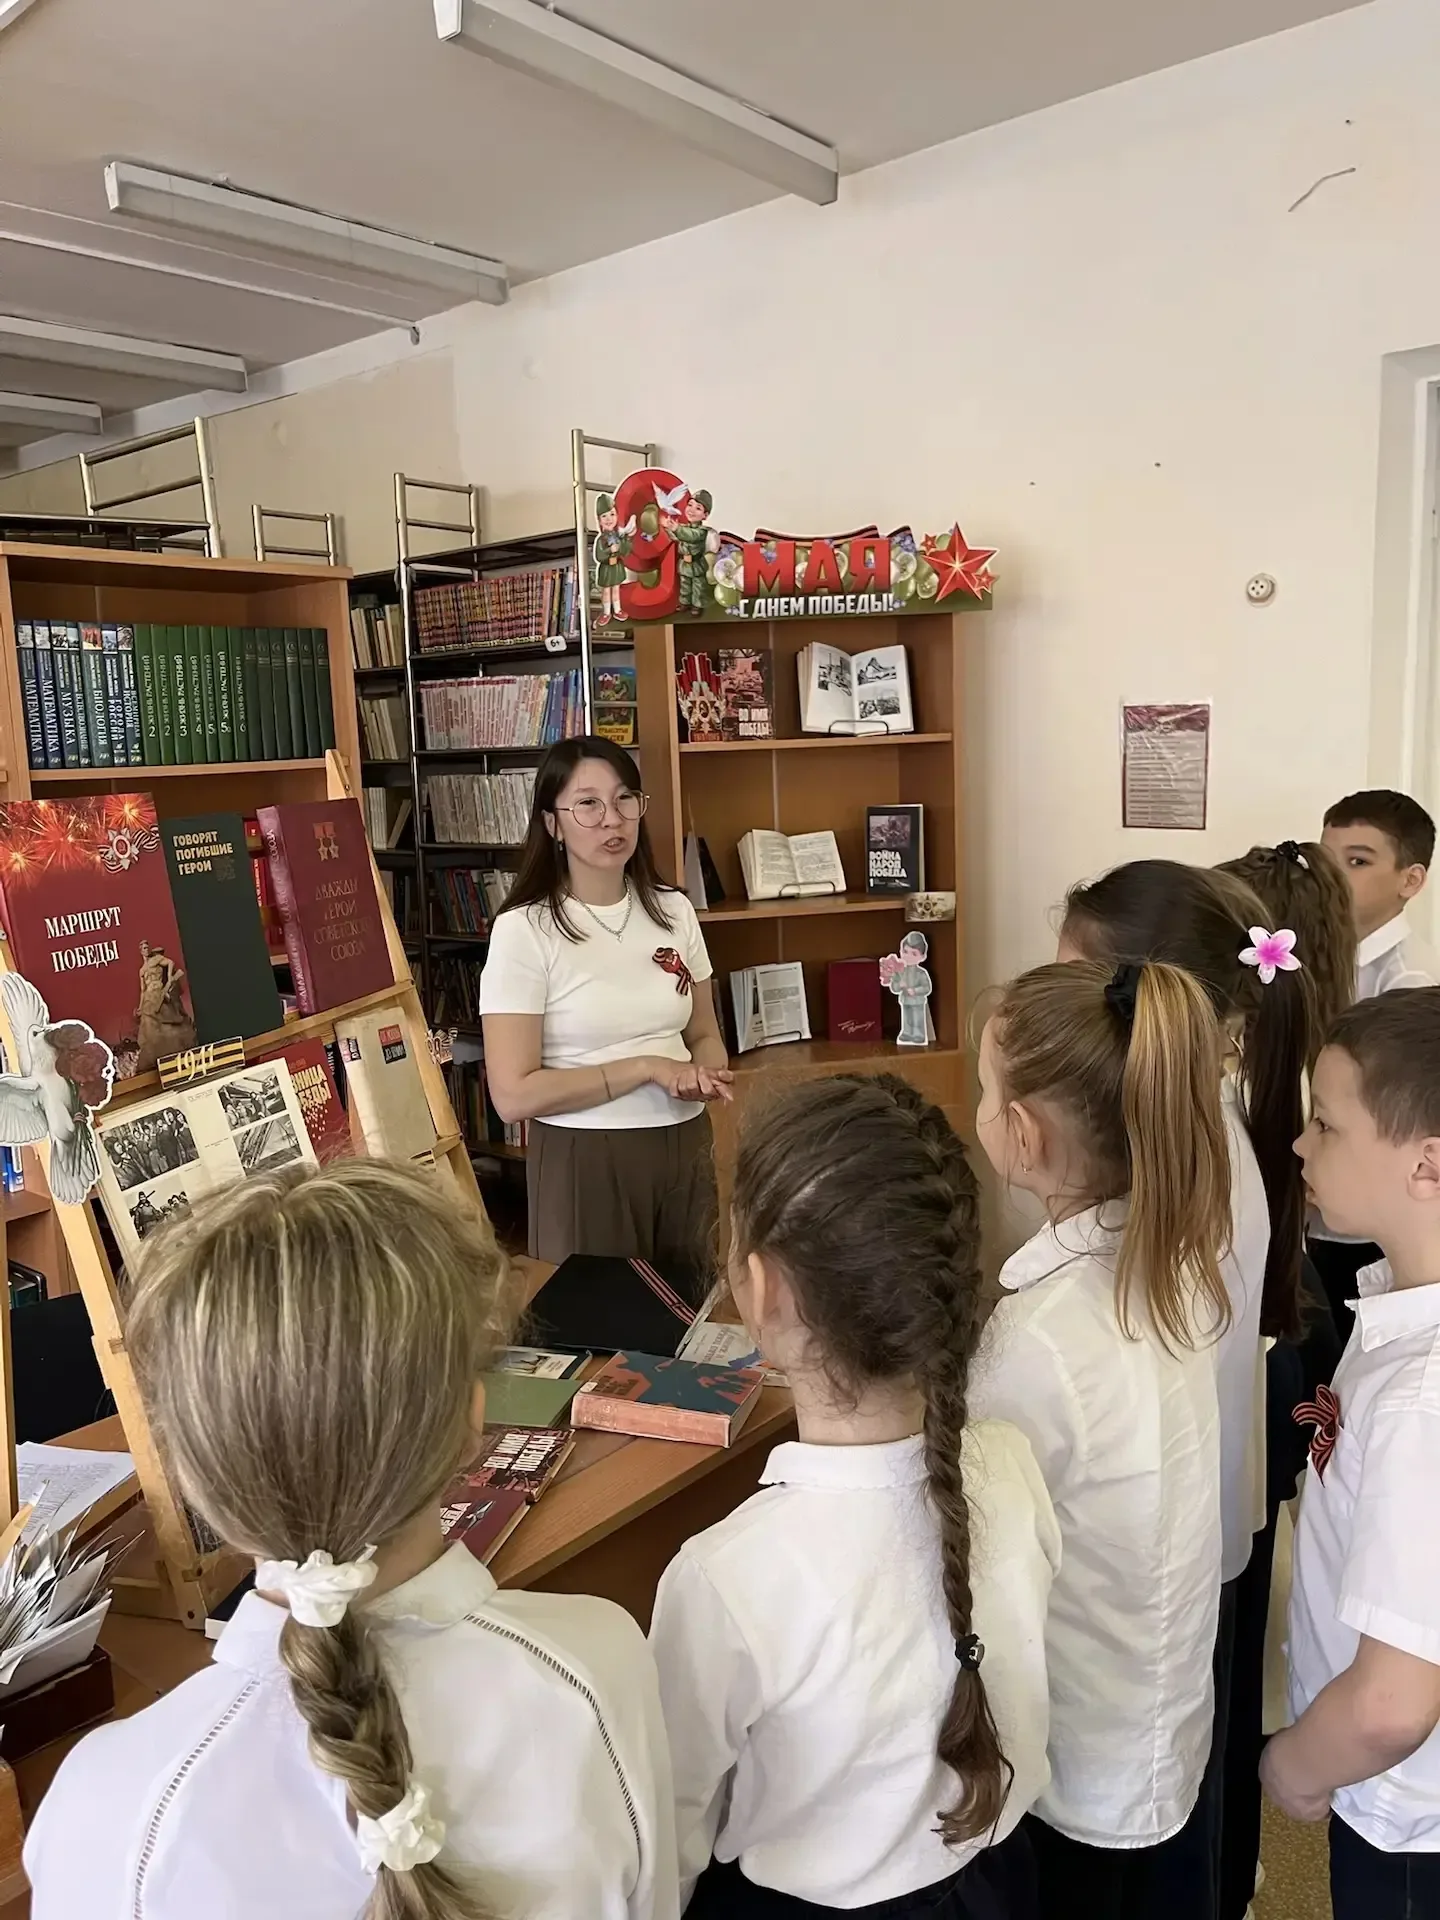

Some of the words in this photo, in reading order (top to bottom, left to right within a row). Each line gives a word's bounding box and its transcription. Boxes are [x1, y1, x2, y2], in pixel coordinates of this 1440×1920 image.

[743, 538, 891, 597] МАЯ
[739, 599, 750, 618] С
[752, 596, 805, 619] ДНЕМ
[808, 593, 895, 616] ПОБЕДЫ!
[550, 639, 561, 648] 6+
[25, 679, 43, 752] МАТЕМАТИКА
[43, 679, 59, 753] МАТЕМАТИКА
[61, 692, 76, 745] МУЗЫКА
[93, 690, 108, 745] БИОЛОГИЯ
[108, 700, 118, 740] РОССИИ
[115, 700, 125, 740] ГОРОДА
[123, 691, 134, 728] ИСТОРИЯ
[131, 691, 140, 738] ВСЕМИРНАЯ
[173, 831, 218, 847] ГОВОРЯТ
[175, 843, 234, 861] ПОГИБШИЕ
[869, 849, 901, 860] ВОЙНА
[178, 860, 212, 876] ГЕРОИ
[869, 868, 907, 878] ПОБЕДА
[315, 877, 359, 901] ДВАЖДЫ
[44, 906, 121, 939] МАРШРУТ
[51, 940, 120, 973] ПОБЕДЫ
[175, 1043, 214, 1081] 1941
[296, 1081, 332, 1107] БЕДЫ
[494, 1433, 530, 1455] ИМЯ
[510, 1435, 557, 1472] ПОБЕДЫ
[482, 1455, 513, 1470] ВО
